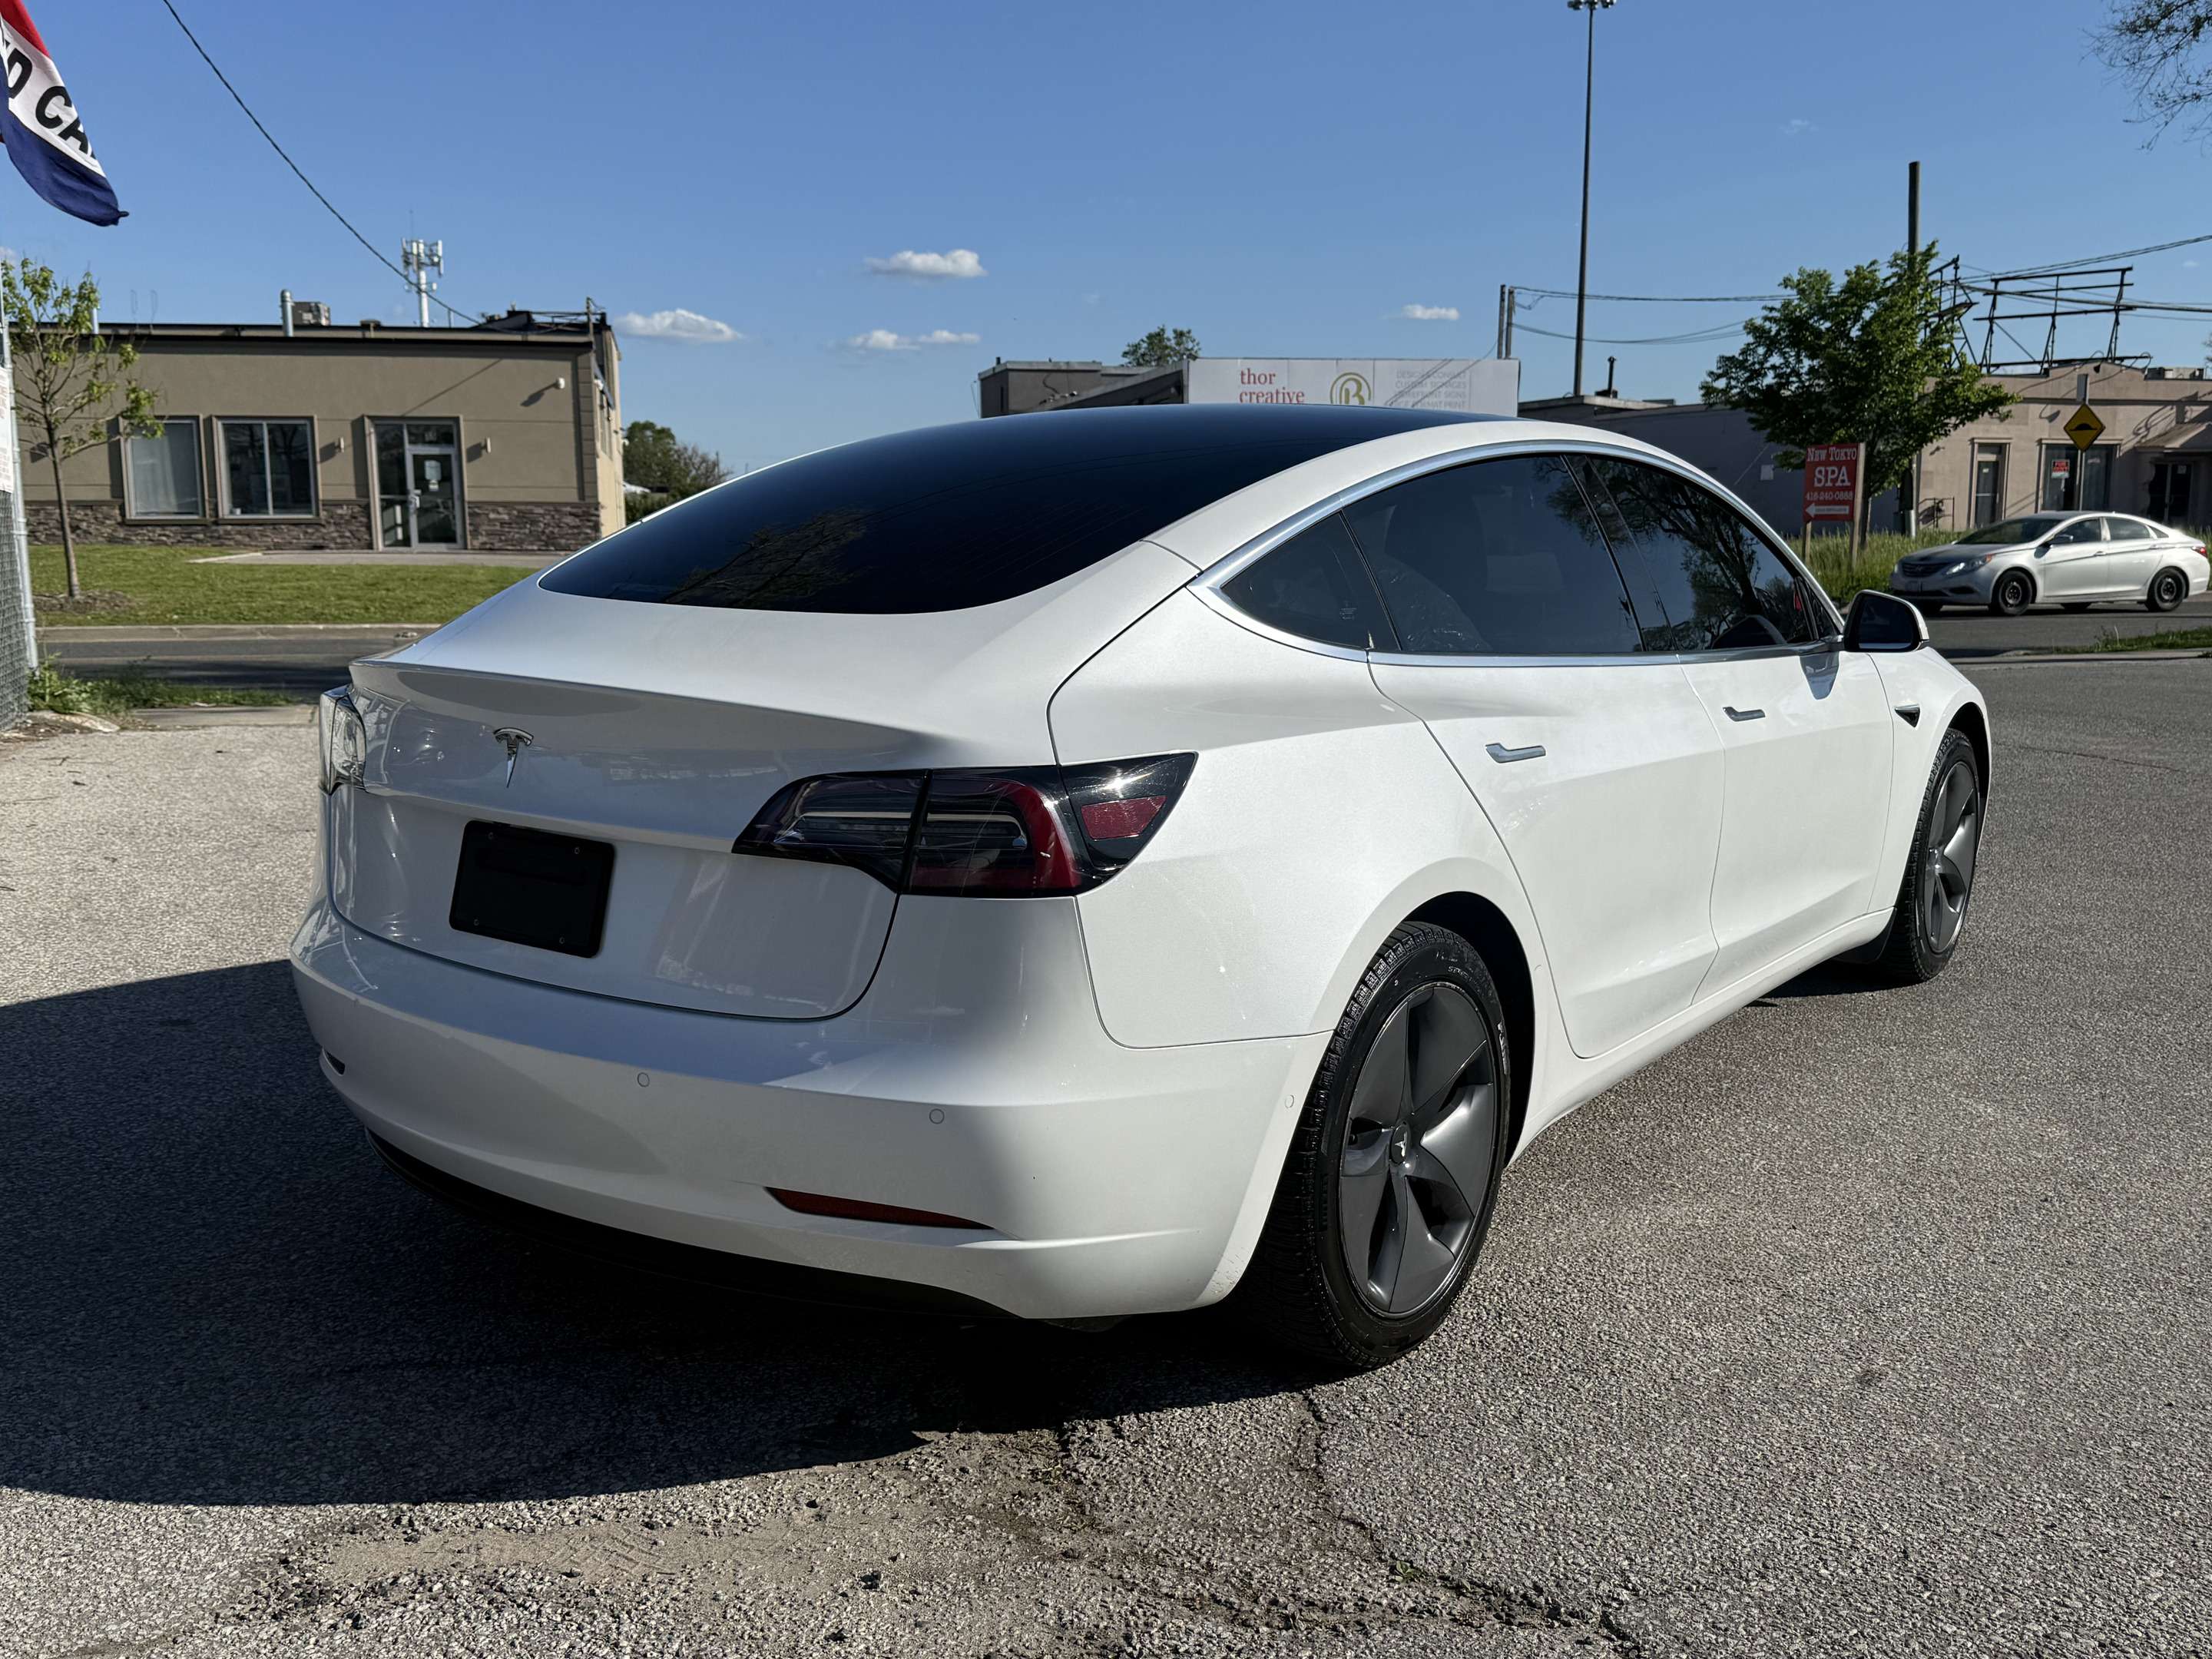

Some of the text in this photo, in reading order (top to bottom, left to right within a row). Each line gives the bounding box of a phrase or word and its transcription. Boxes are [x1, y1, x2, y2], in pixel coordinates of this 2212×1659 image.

[1240, 368, 1276, 385] thor
[1239, 387, 1305, 404] creative
[1807, 447, 1857, 461] NEW TOKYO
[1814, 466, 1851, 487] SPA
